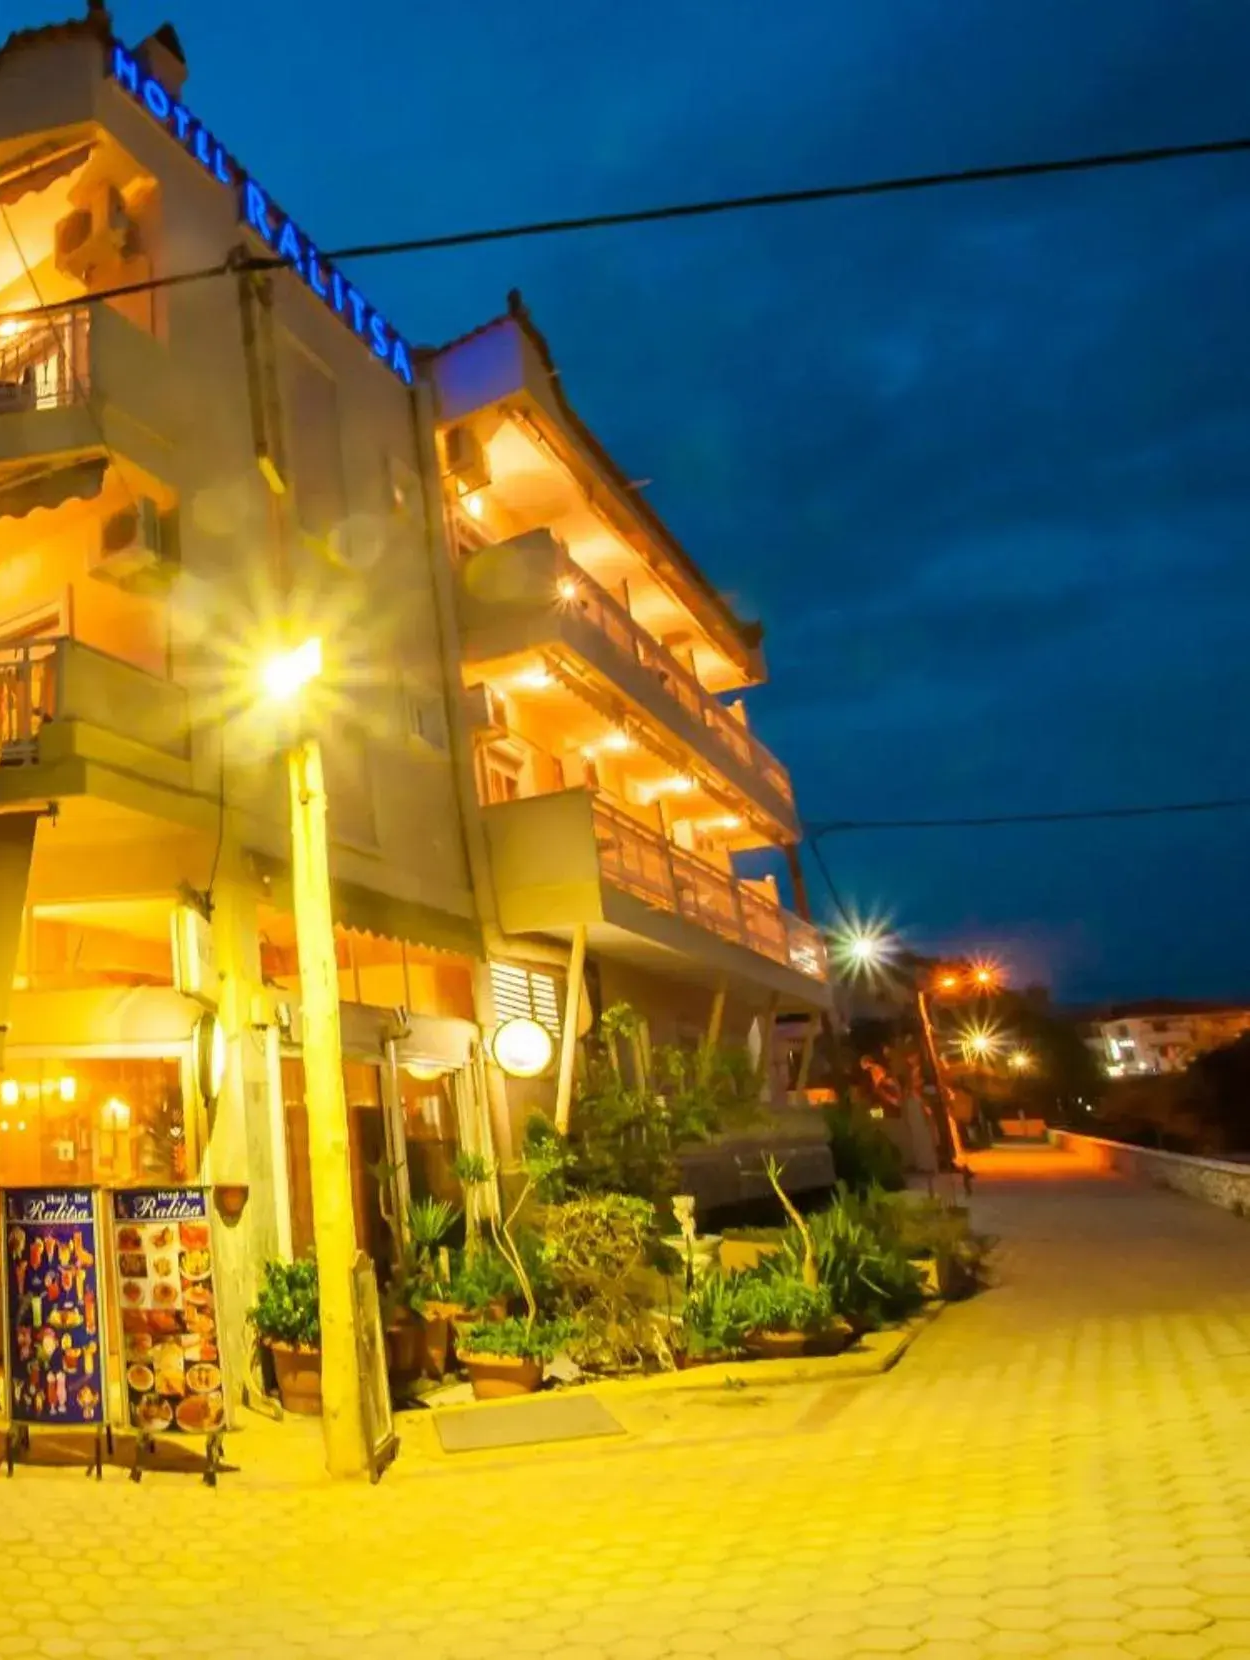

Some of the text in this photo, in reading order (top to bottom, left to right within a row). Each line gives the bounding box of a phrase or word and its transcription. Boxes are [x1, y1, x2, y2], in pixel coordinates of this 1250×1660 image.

[246, 181, 412, 384] RALITSA
[25, 1200, 88, 1221] Ralitsa
[134, 1196, 200, 1218] Ralitsa
